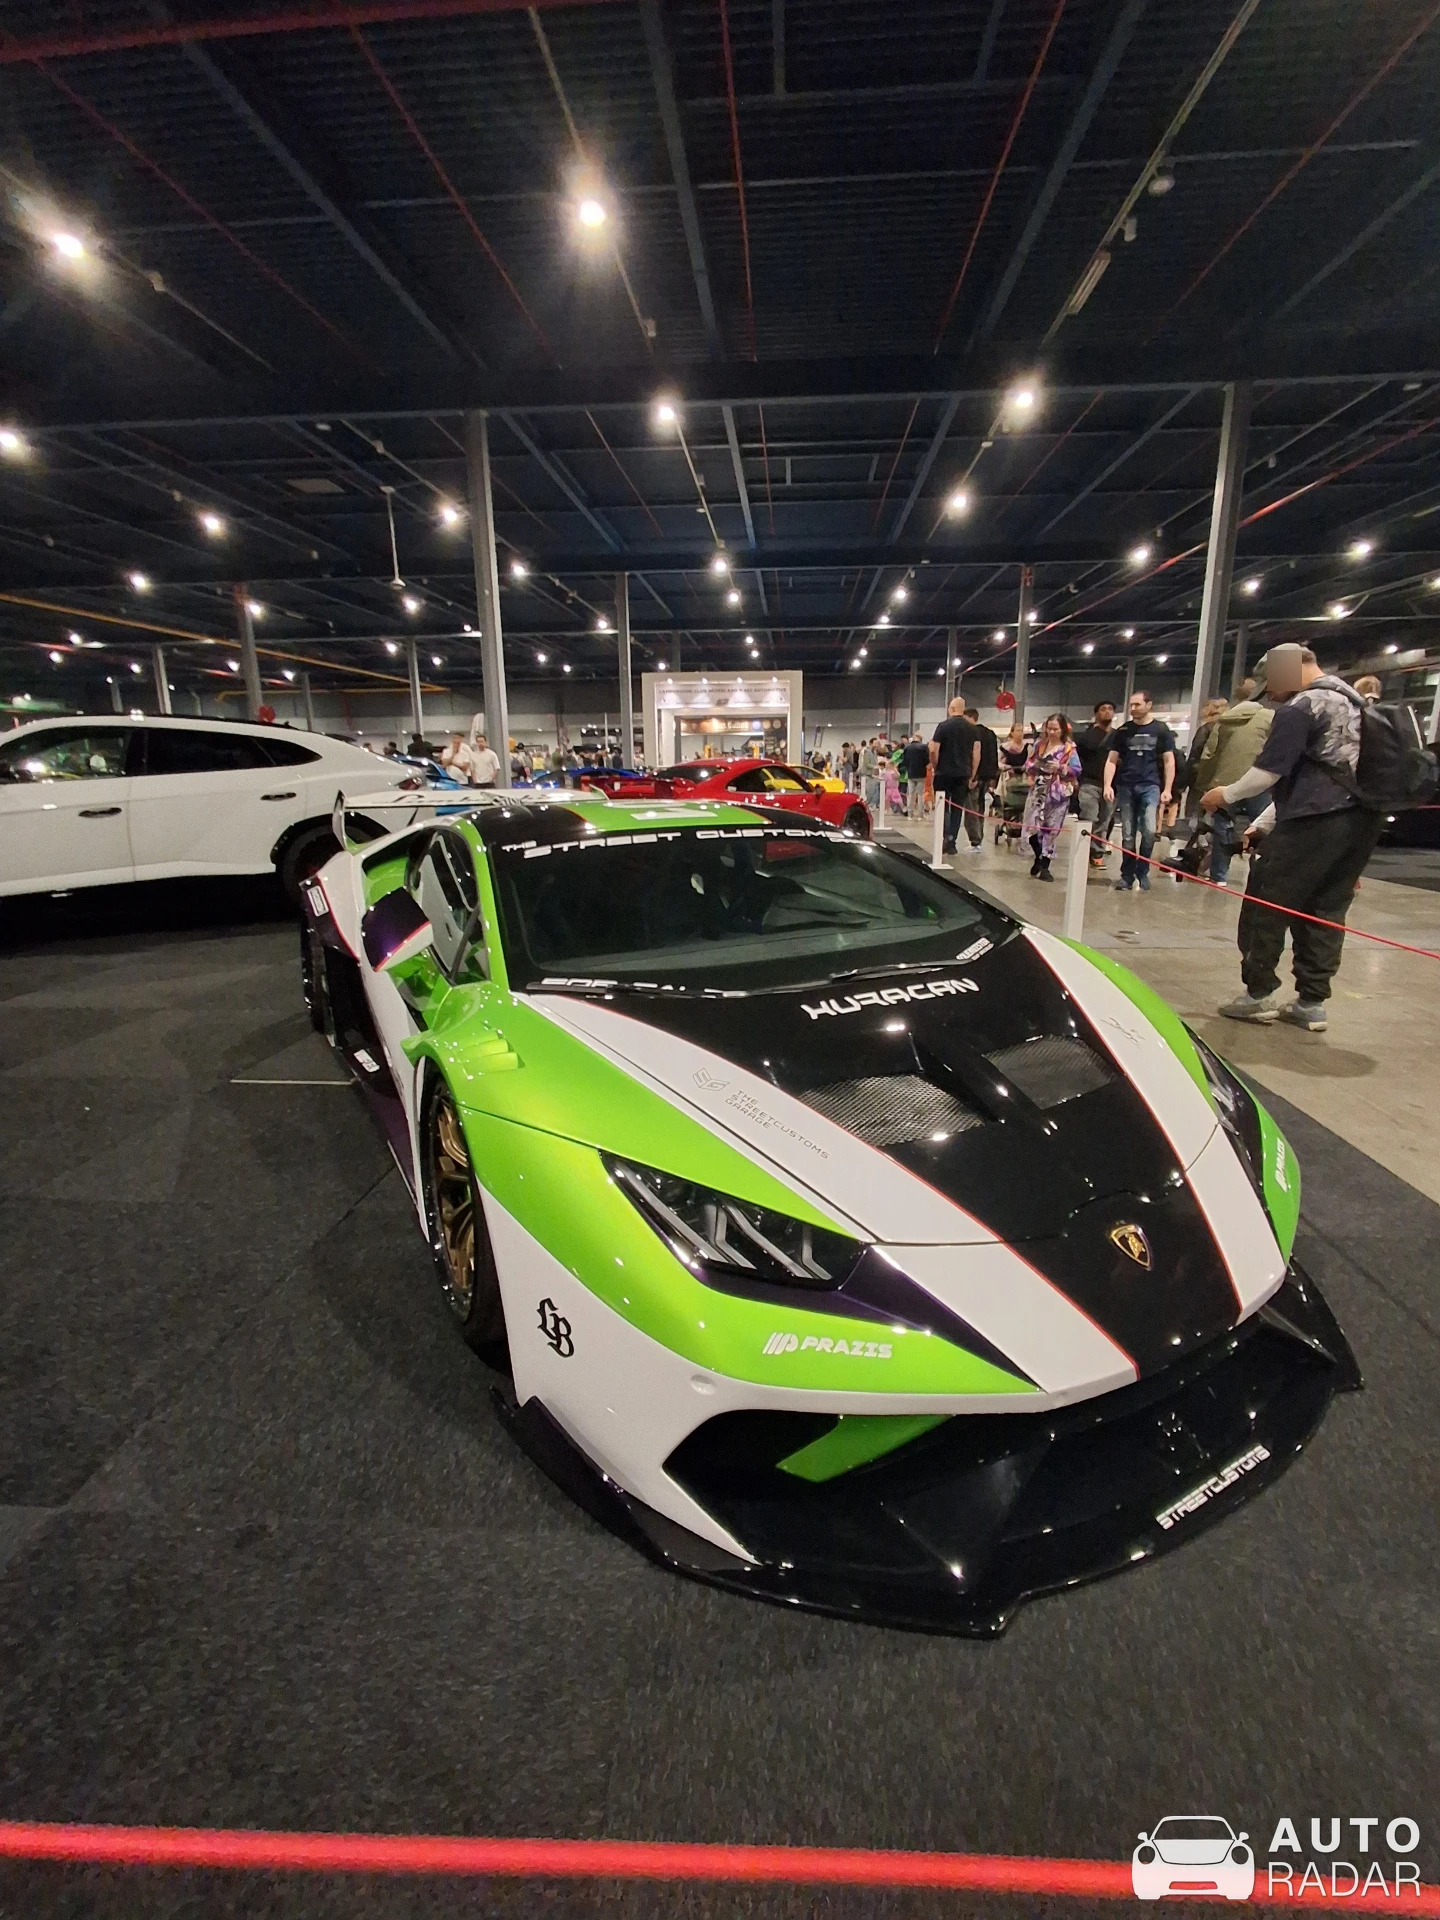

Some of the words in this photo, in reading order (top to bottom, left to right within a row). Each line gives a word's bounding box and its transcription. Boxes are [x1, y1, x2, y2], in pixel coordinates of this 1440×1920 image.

[502, 840, 537, 852] THE
[524, 832, 682, 859] STREET
[696, 829, 846, 839] CUSTOMS
[736, 1089, 759, 1106] THE
[724, 1098, 772, 1129] GARAGE
[730, 1093, 830, 1160] STREETCUSTOMS
[800, 1335, 893, 1359] PRAZIS
